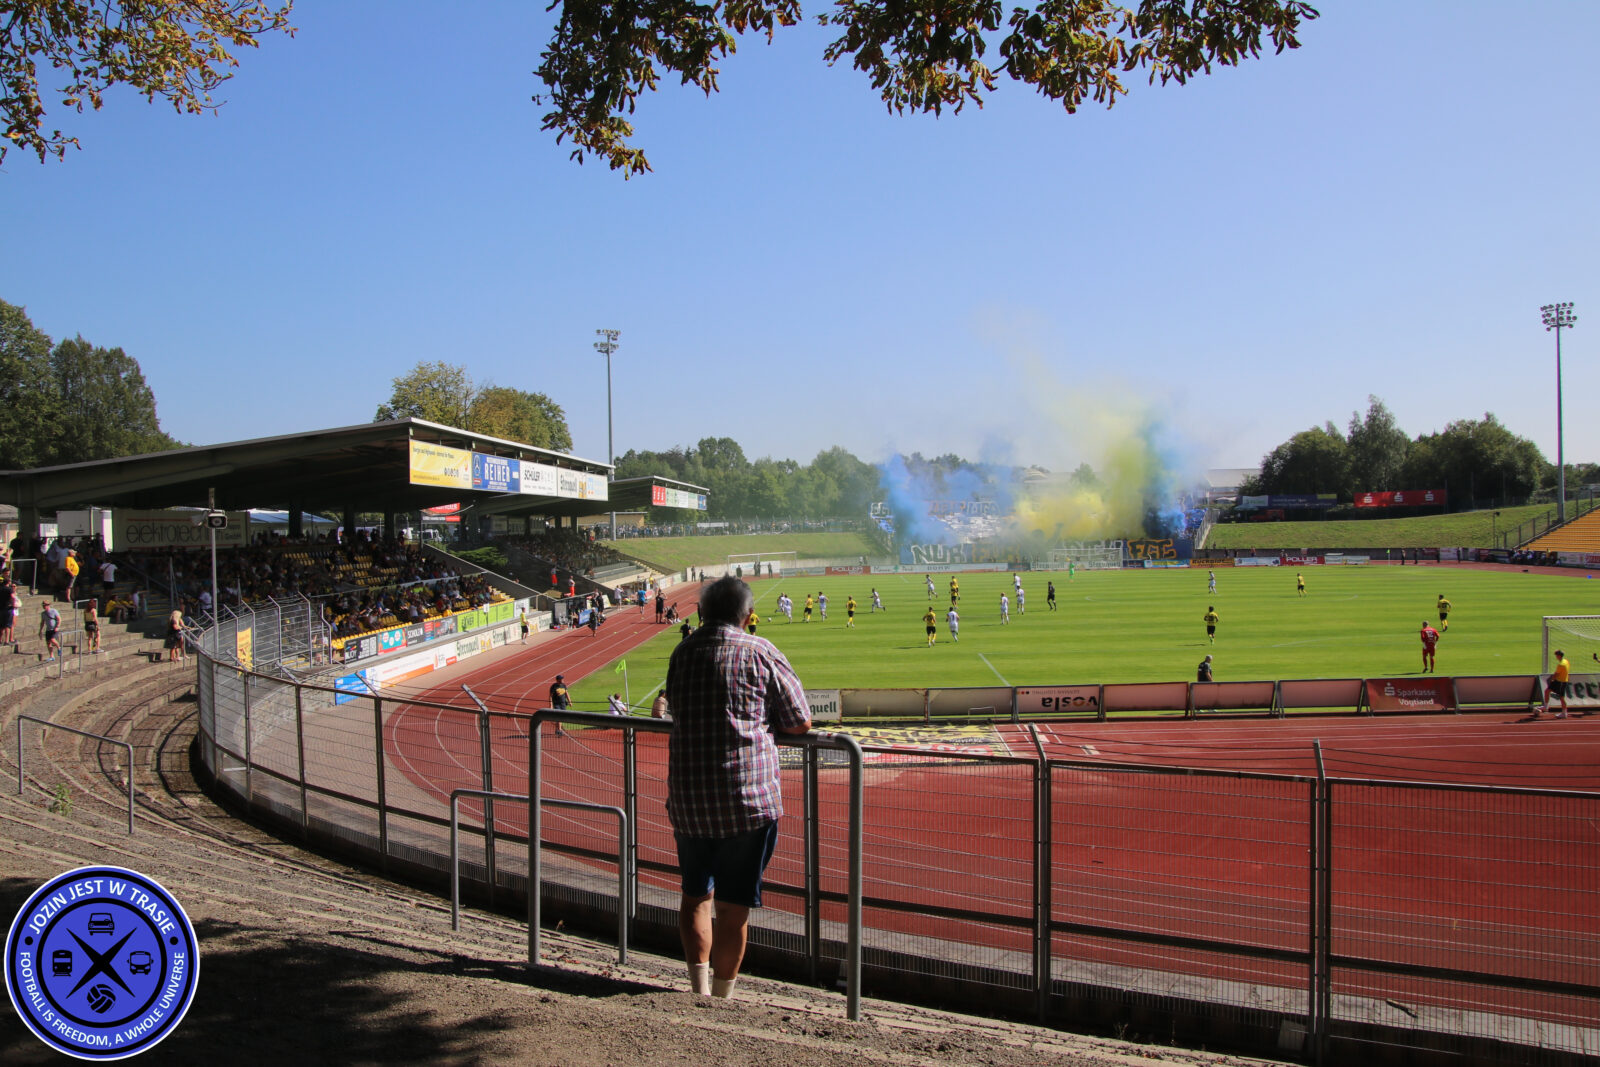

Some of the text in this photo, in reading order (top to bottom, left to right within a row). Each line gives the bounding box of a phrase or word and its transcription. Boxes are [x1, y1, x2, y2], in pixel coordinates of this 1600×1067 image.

[1397, 688, 1436, 697] Sparkasse
[1041, 696, 1097, 711] vosla
[1398, 698, 1434, 707] Vogtland
